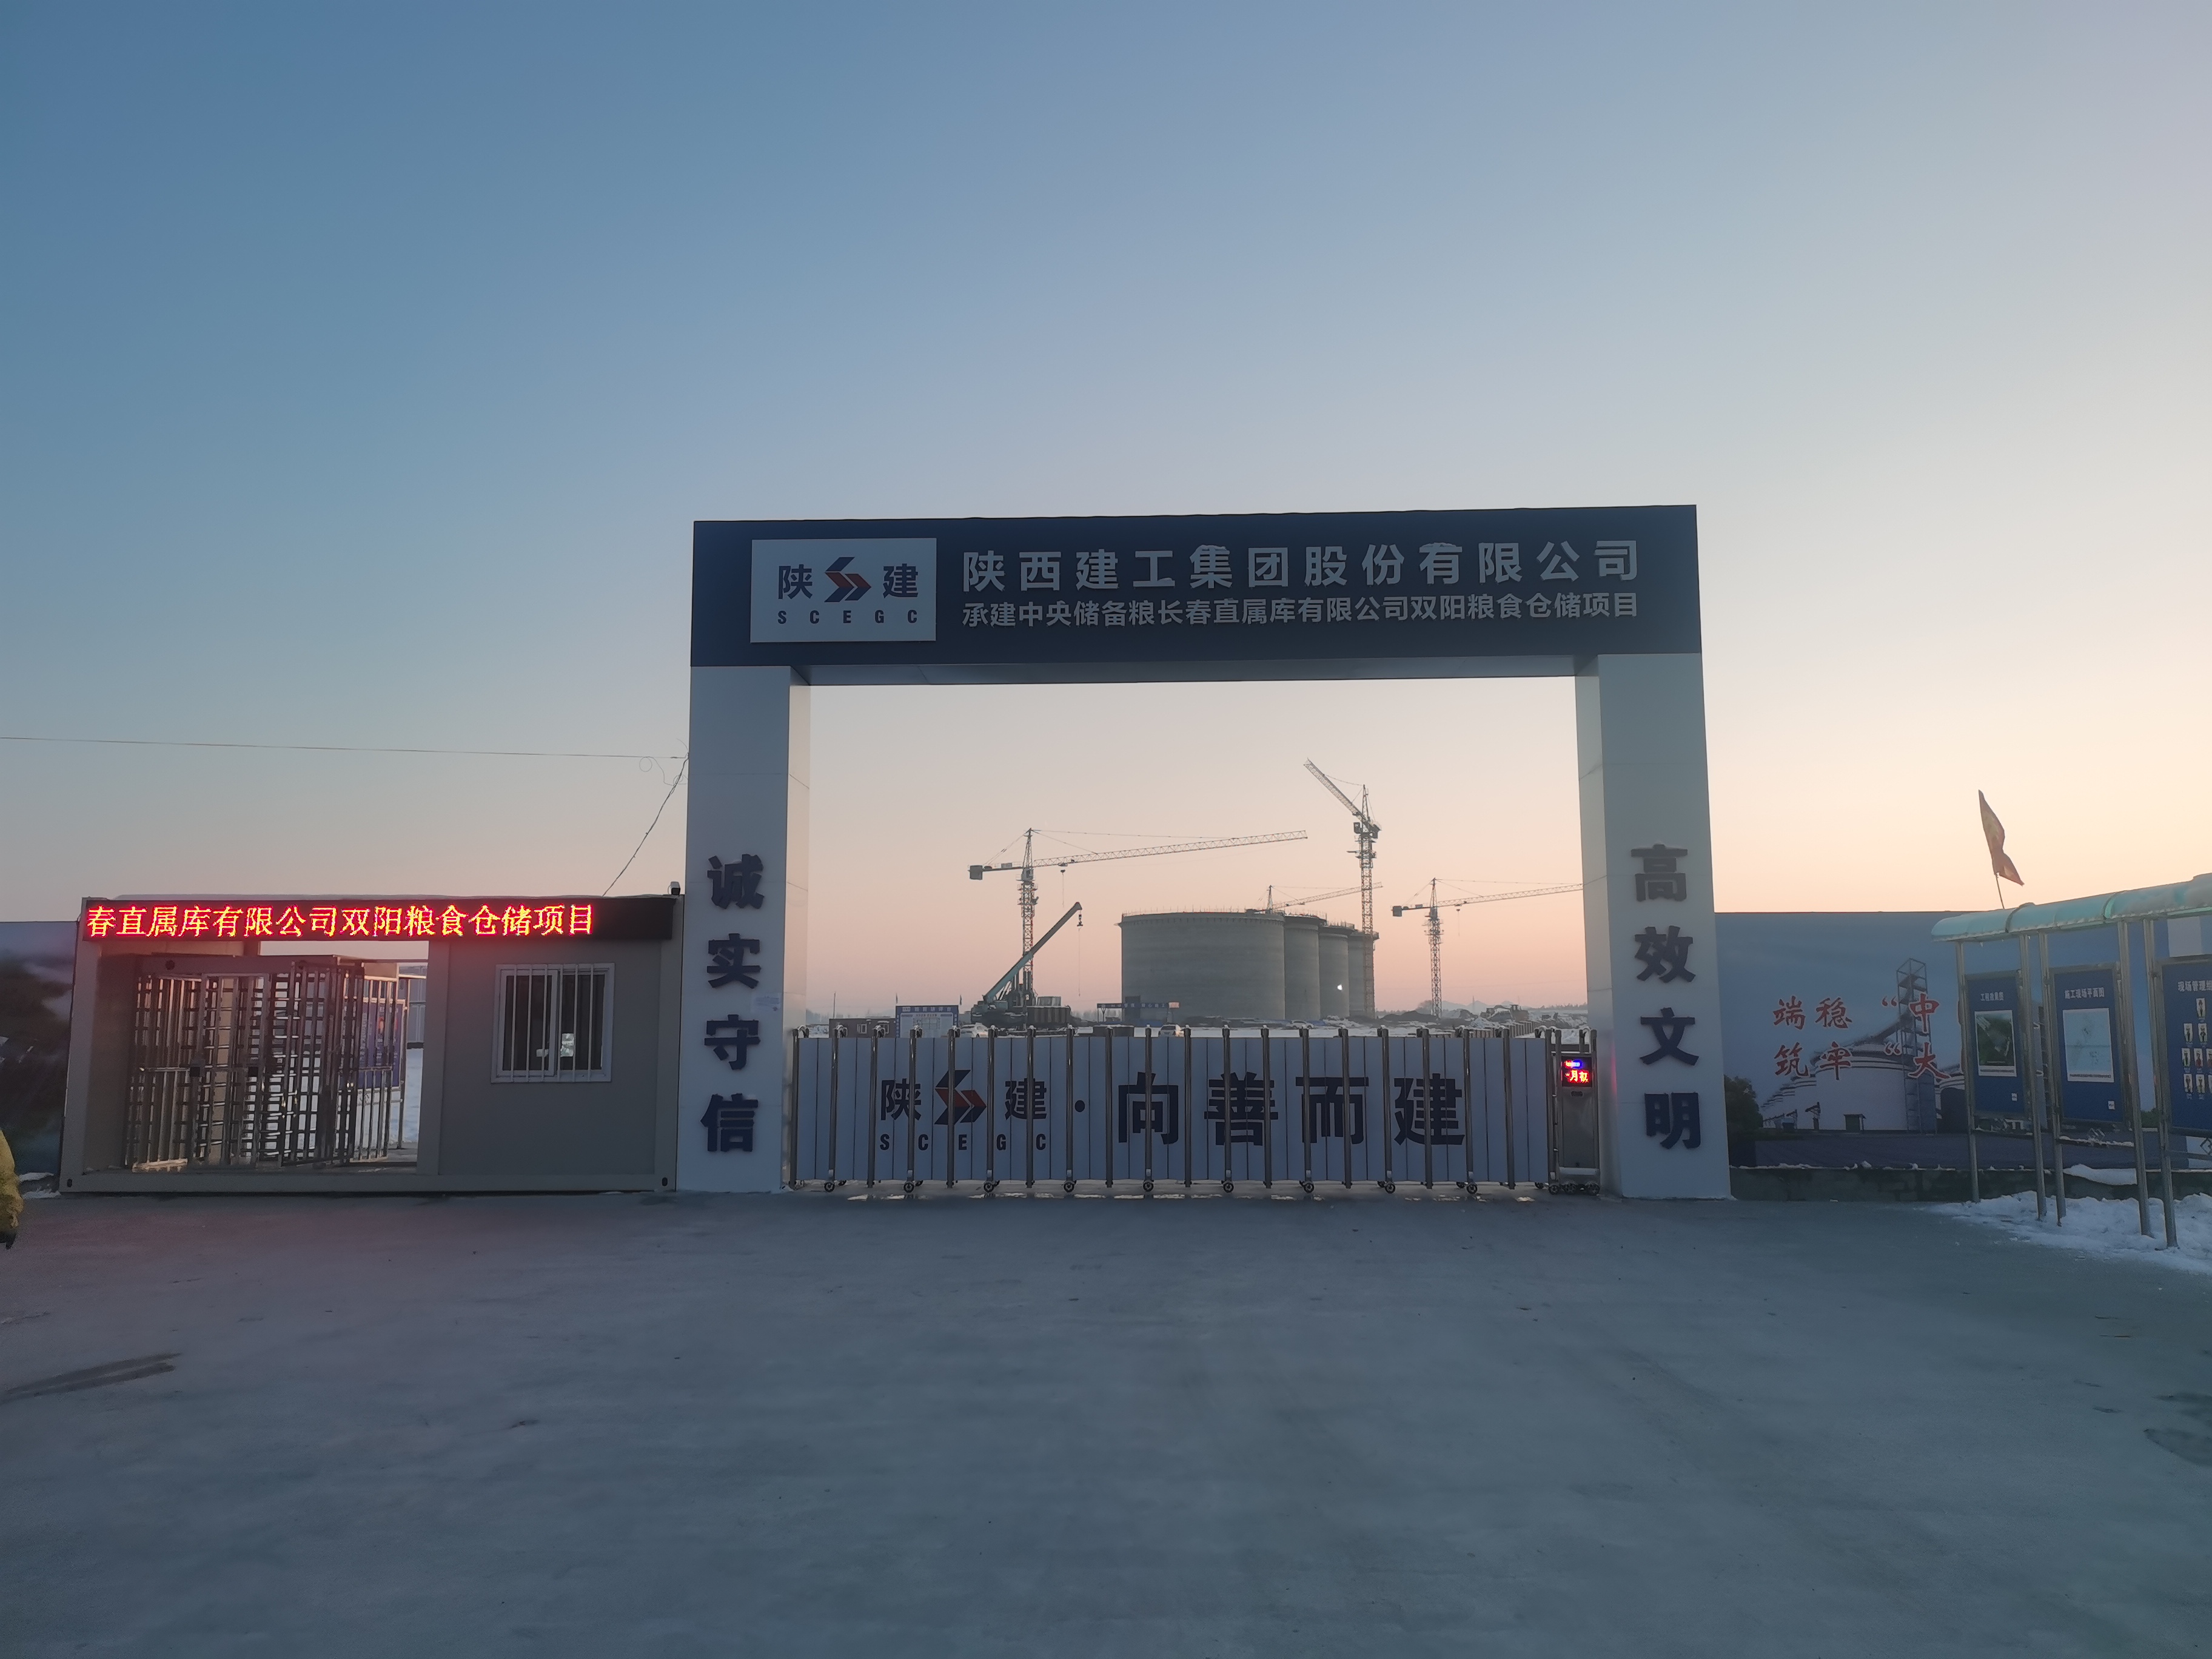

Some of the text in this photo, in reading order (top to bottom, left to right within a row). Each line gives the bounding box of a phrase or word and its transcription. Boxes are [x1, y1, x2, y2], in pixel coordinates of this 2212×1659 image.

[962, 539, 1638, 592] 陕西建工集团股份有限公司
[962, 592, 1638, 628] 承建中央储备粮长春直属库有限公司双阳粮食仓储项目
[85, 903, 594, 939] 春直属库有限公司双阳粮食仓储项目
[700, 853, 765, 1153] 诚实守信
[1631, 843, 1702, 1150] 高效文明
